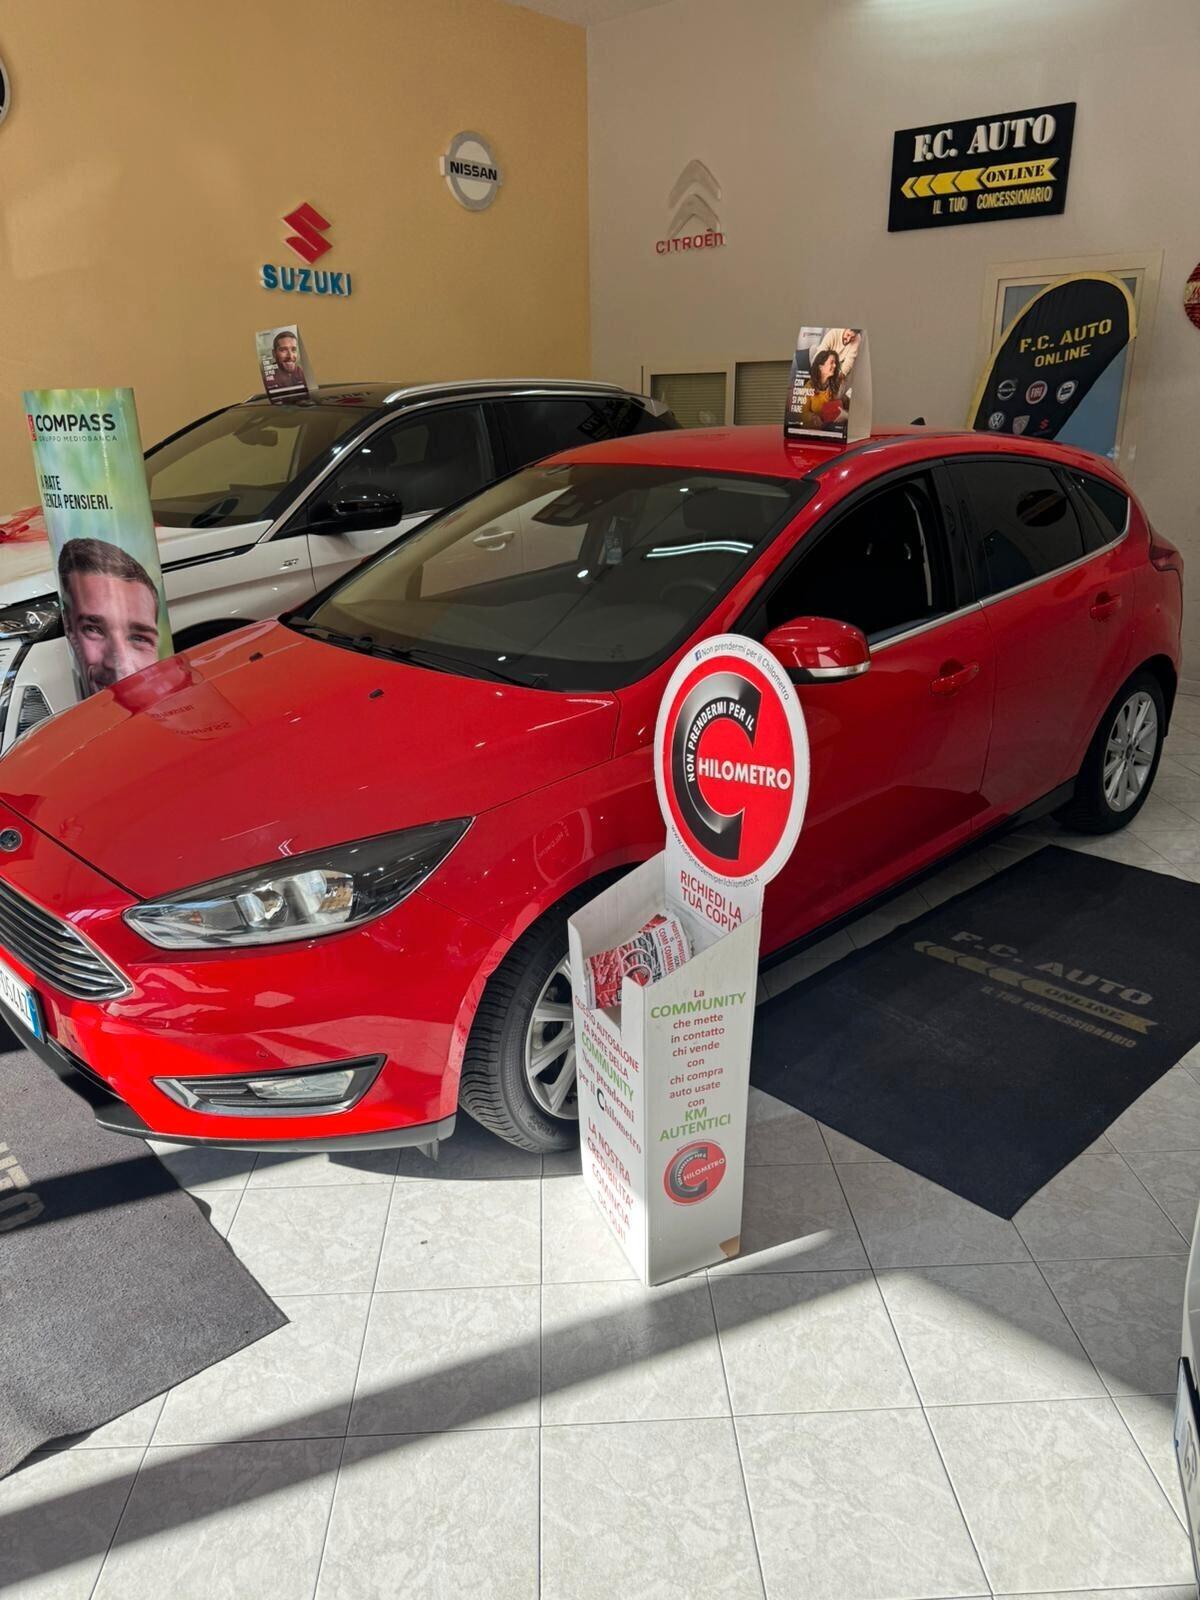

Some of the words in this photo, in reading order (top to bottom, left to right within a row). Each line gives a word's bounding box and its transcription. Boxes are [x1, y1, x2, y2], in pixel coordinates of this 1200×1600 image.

[912, 129, 959, 163] F.C.
[966, 113, 1057, 155] AUTO
[450, 161, 498, 181] NISSAN
[986, 164, 1045, 183] ONLINE
[932, 199, 943, 215] IL
[949, 197, 968, 213] TUO
[976, 186, 1053, 210] CONCESSIONARIO
[260, 264, 352, 296] SUZUKI
[1019, 335, 1054, 353] F.C.
[1060, 318, 1112, 345] AUTO
[1034, 344, 1091, 367] ONLINE
[36, 413, 116, 432] COMPASS
[63, 494, 113, 510] PENSIERI.
[701, 645, 714, 656] Non
[714, 642, 746, 652] prendermi
[746, 648, 757, 658] per
[761, 658, 790, 701] Chilometro
[688, 701, 727, 750] PRENDERMI
[728, 702, 746, 722] PER
[745, 714, 754, 731] IL
[686, 753, 696, 782] NON
[680, 870, 726, 911] RICHIEDI
[729, 901, 743, 923] LA
[682, 887, 703, 913] TUA
[951, 930, 1024, 964] F.C.
[1034, 961, 1153, 1005] AUTO
[650, 992, 747, 1019] COMMUNITY
[693, 989, 705, 998] La
[1042, 986, 1126, 1021] ONLINE
[575, 994, 596, 1026] QUESTO
[596, 1021, 640, 1073] AUTOSALONE
[670, 1034, 681, 1044] in
[683, 1027, 725, 1041] contatto
[673, 1019, 691, 1029] che
[693, 1014, 724, 1026] mette
[591, 1030, 608, 1057] PARTE
[608, 1051, 629, 1080] DELLA
[672, 1046, 687, 1057] chi
[689, 1041, 720, 1054] vende
[687, 1058, 705, 1068] con
[581, 1031, 634, 1102] COMMUNITY
[670, 1074, 684, 1086] chi
[687, 1067, 724, 1081] compra
[595, 1070, 635, 1123] prendermi
[669, 1087, 692, 1099] auto
[695, 1080, 721, 1093] usate
[687, 1098, 705, 1108] con
[596, 1087, 642, 1154] Chilometro
[659, 1113, 731, 1142] AUTENTICI
[685, 1106, 708, 1122] KM
[588, 1117, 597, 1139] LA
[598, 1131, 632, 1187] NOSTRA
[591, 1162, 631, 1230] COMINCIA
